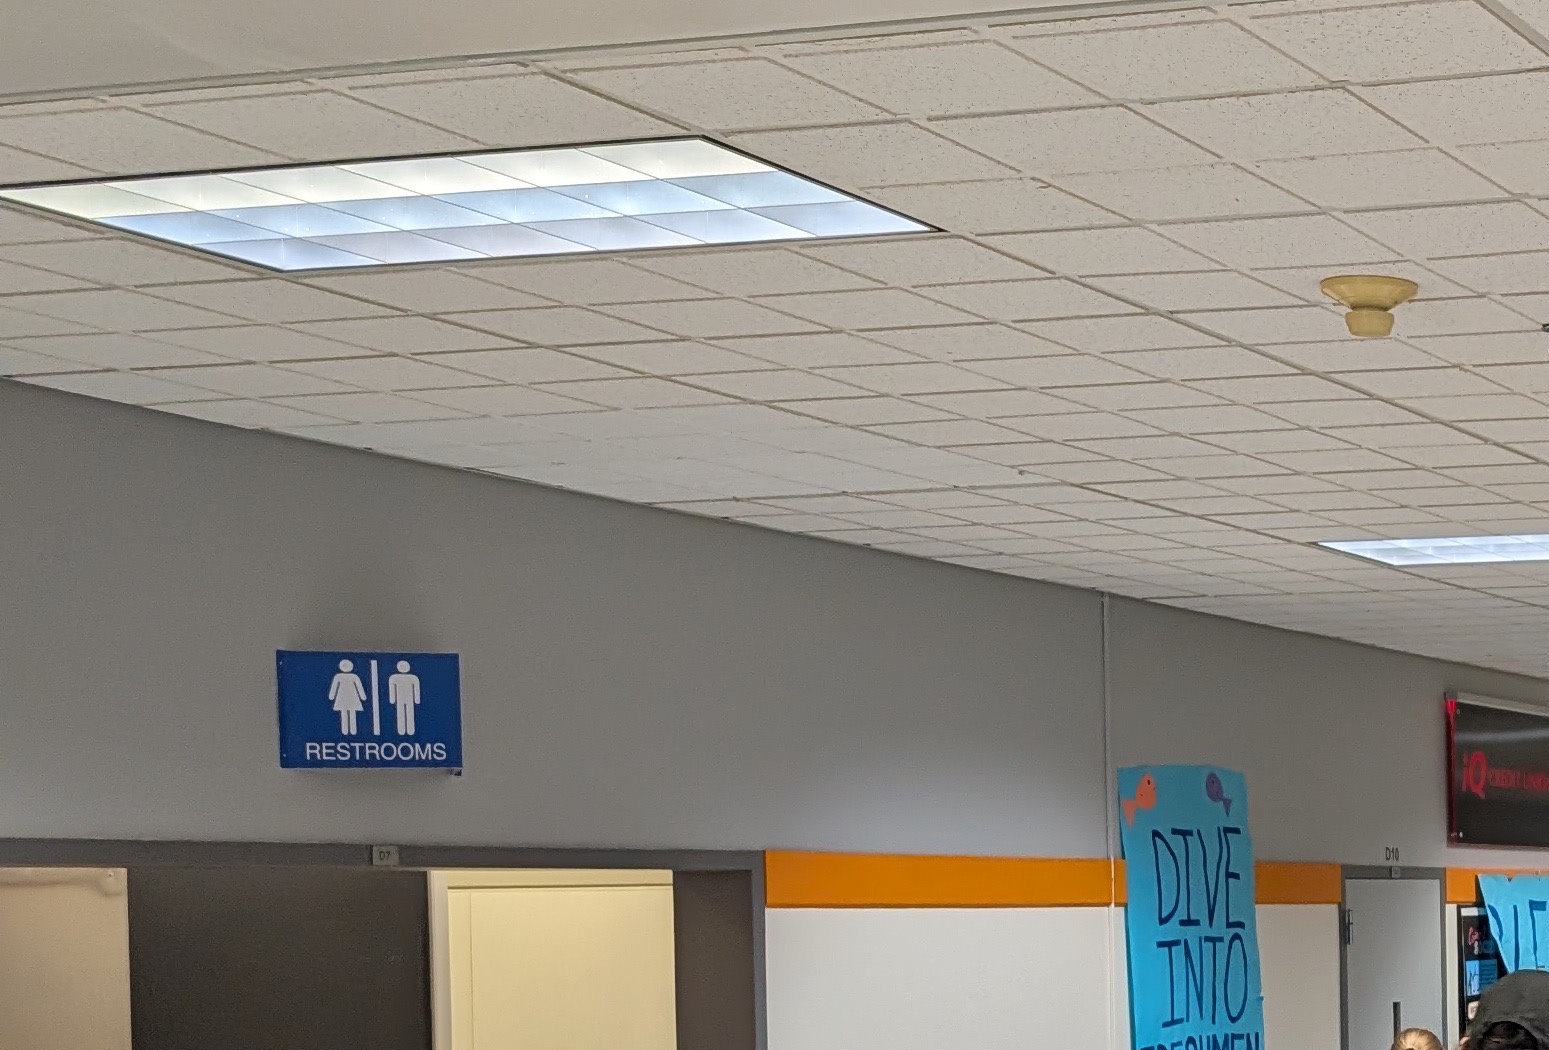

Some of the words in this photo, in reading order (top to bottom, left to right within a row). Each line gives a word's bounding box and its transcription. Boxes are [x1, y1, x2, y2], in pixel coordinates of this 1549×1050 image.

[305, 742, 447, 761] RESTROOMS
[1151, 826, 1246, 930] DIVE
[1156, 932, 1248, 1029] INTO
